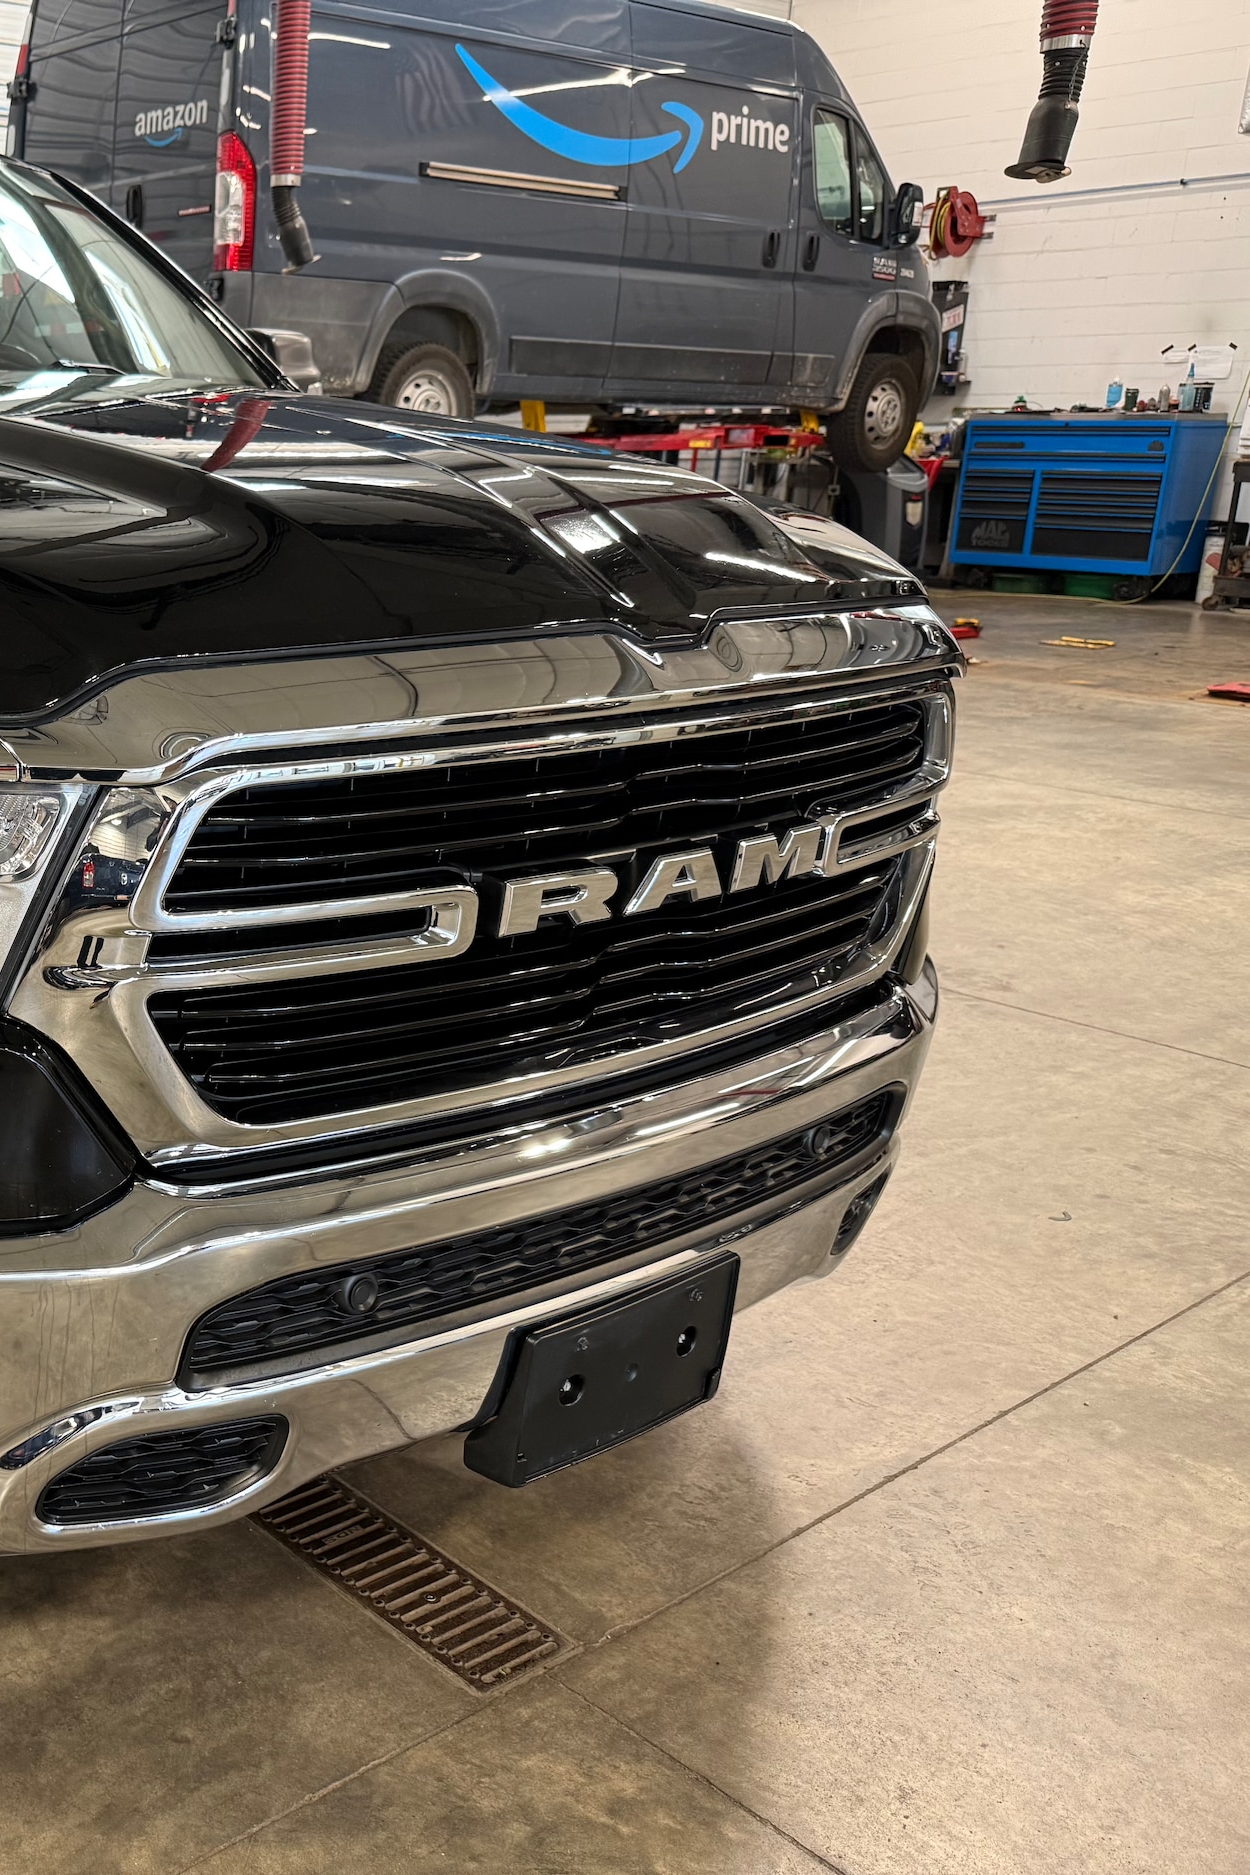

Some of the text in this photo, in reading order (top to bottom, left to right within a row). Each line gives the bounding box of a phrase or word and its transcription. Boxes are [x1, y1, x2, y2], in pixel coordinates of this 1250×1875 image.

[134, 100, 208, 136] amazon
[710, 105, 790, 153] prime
[498, 824, 822, 938] RAM
